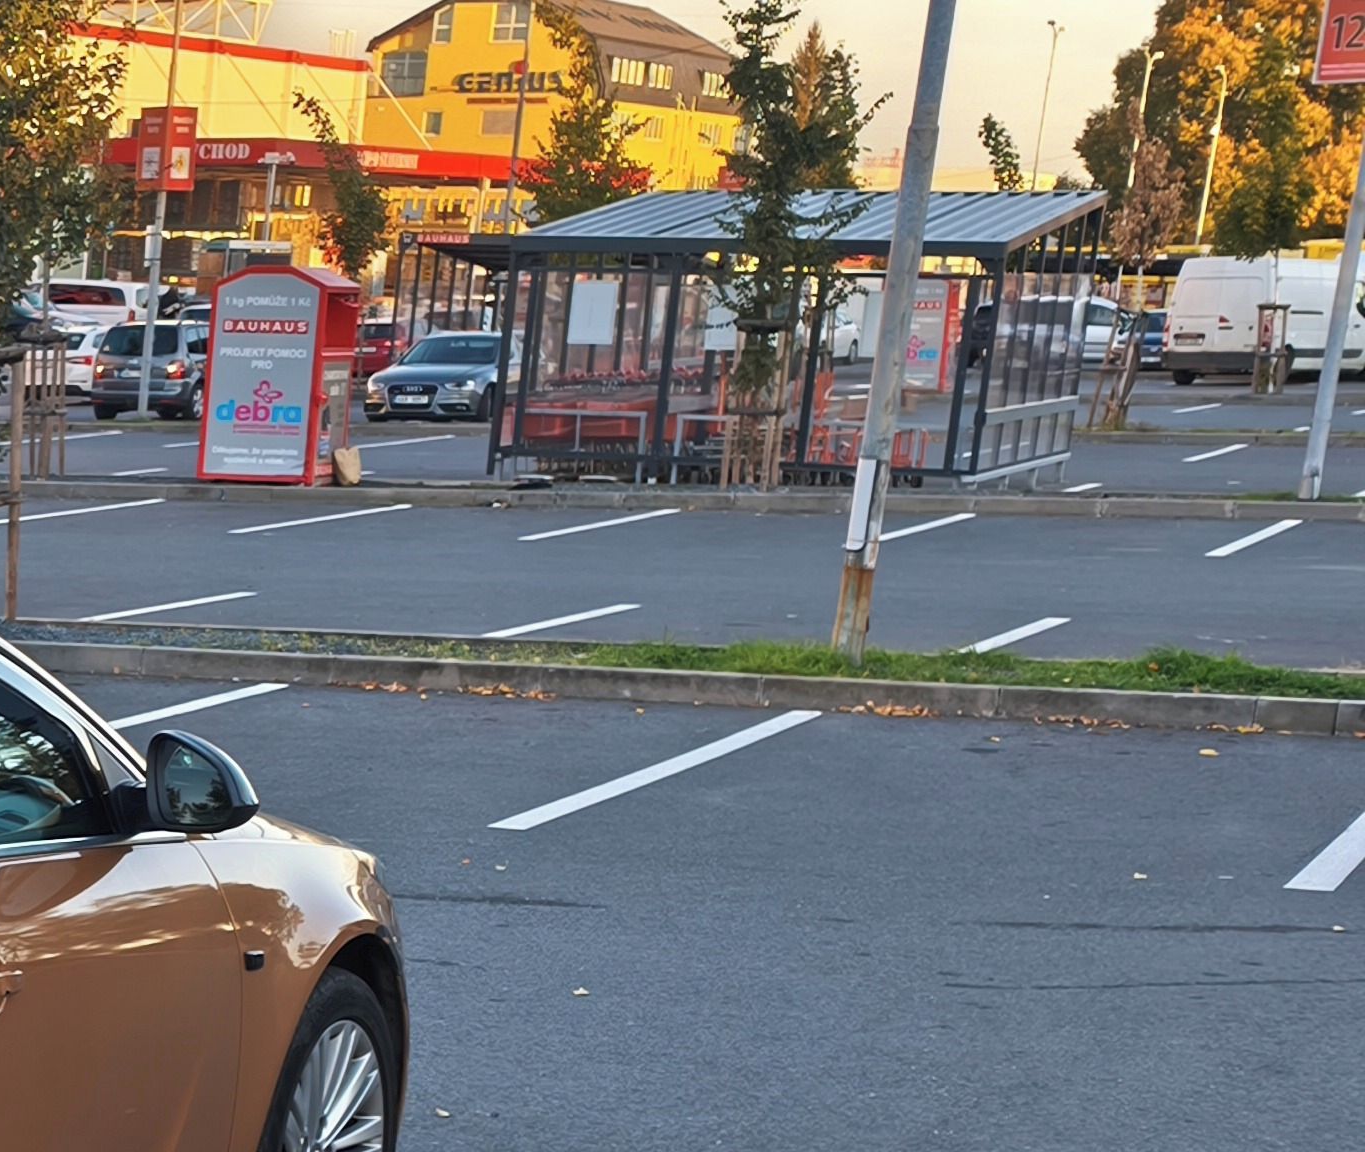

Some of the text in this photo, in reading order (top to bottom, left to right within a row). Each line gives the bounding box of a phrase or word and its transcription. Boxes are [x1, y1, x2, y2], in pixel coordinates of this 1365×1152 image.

[223, 320, 308, 333] BAUHAUS
[220, 346, 266, 358] PROJEKT
[251, 359, 273, 370] PRO
[216, 399, 302, 423] debra
